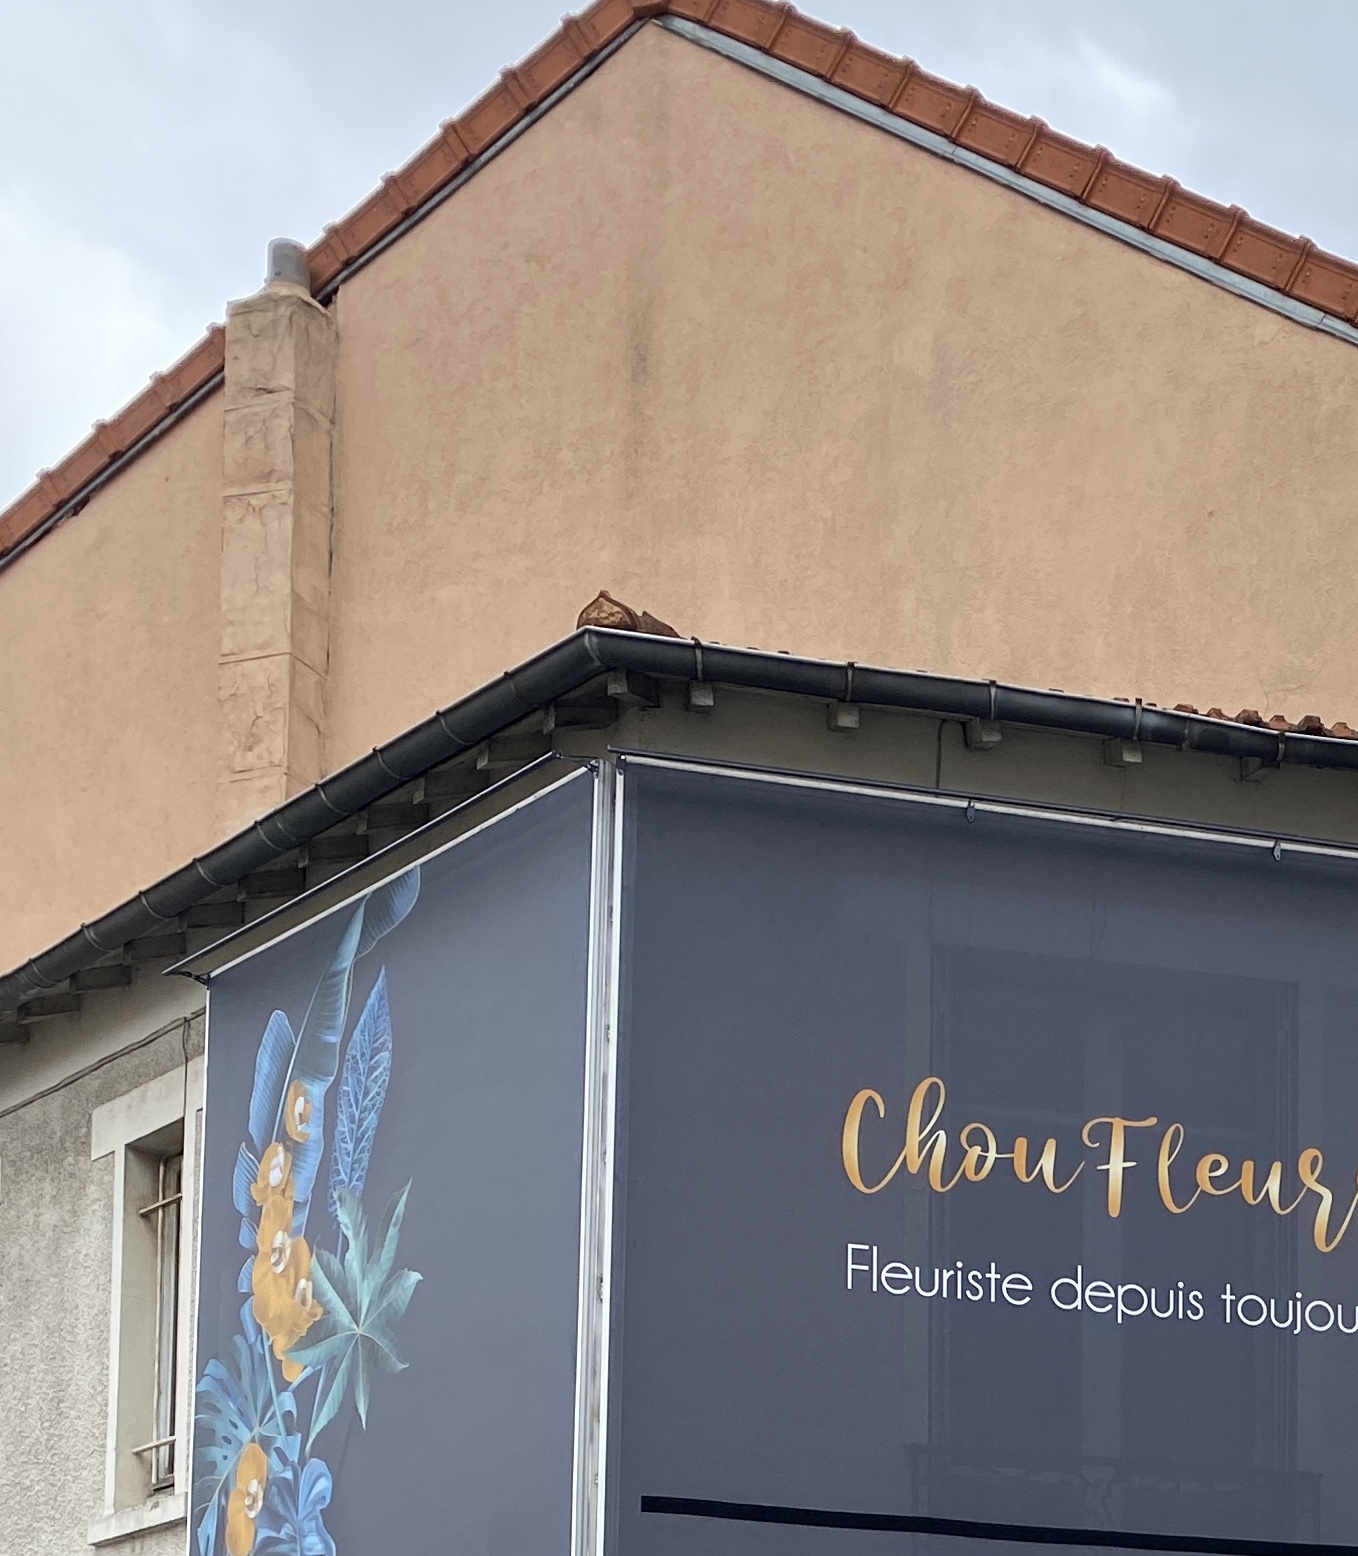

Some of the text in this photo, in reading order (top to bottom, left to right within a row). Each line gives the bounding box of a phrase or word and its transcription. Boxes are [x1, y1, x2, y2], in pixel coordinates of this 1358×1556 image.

[842, 1077, 1085, 1194] Chou
[845, 1243, 1033, 1306] Fleuriste
[1051, 1265, 1204, 1323] depuis
